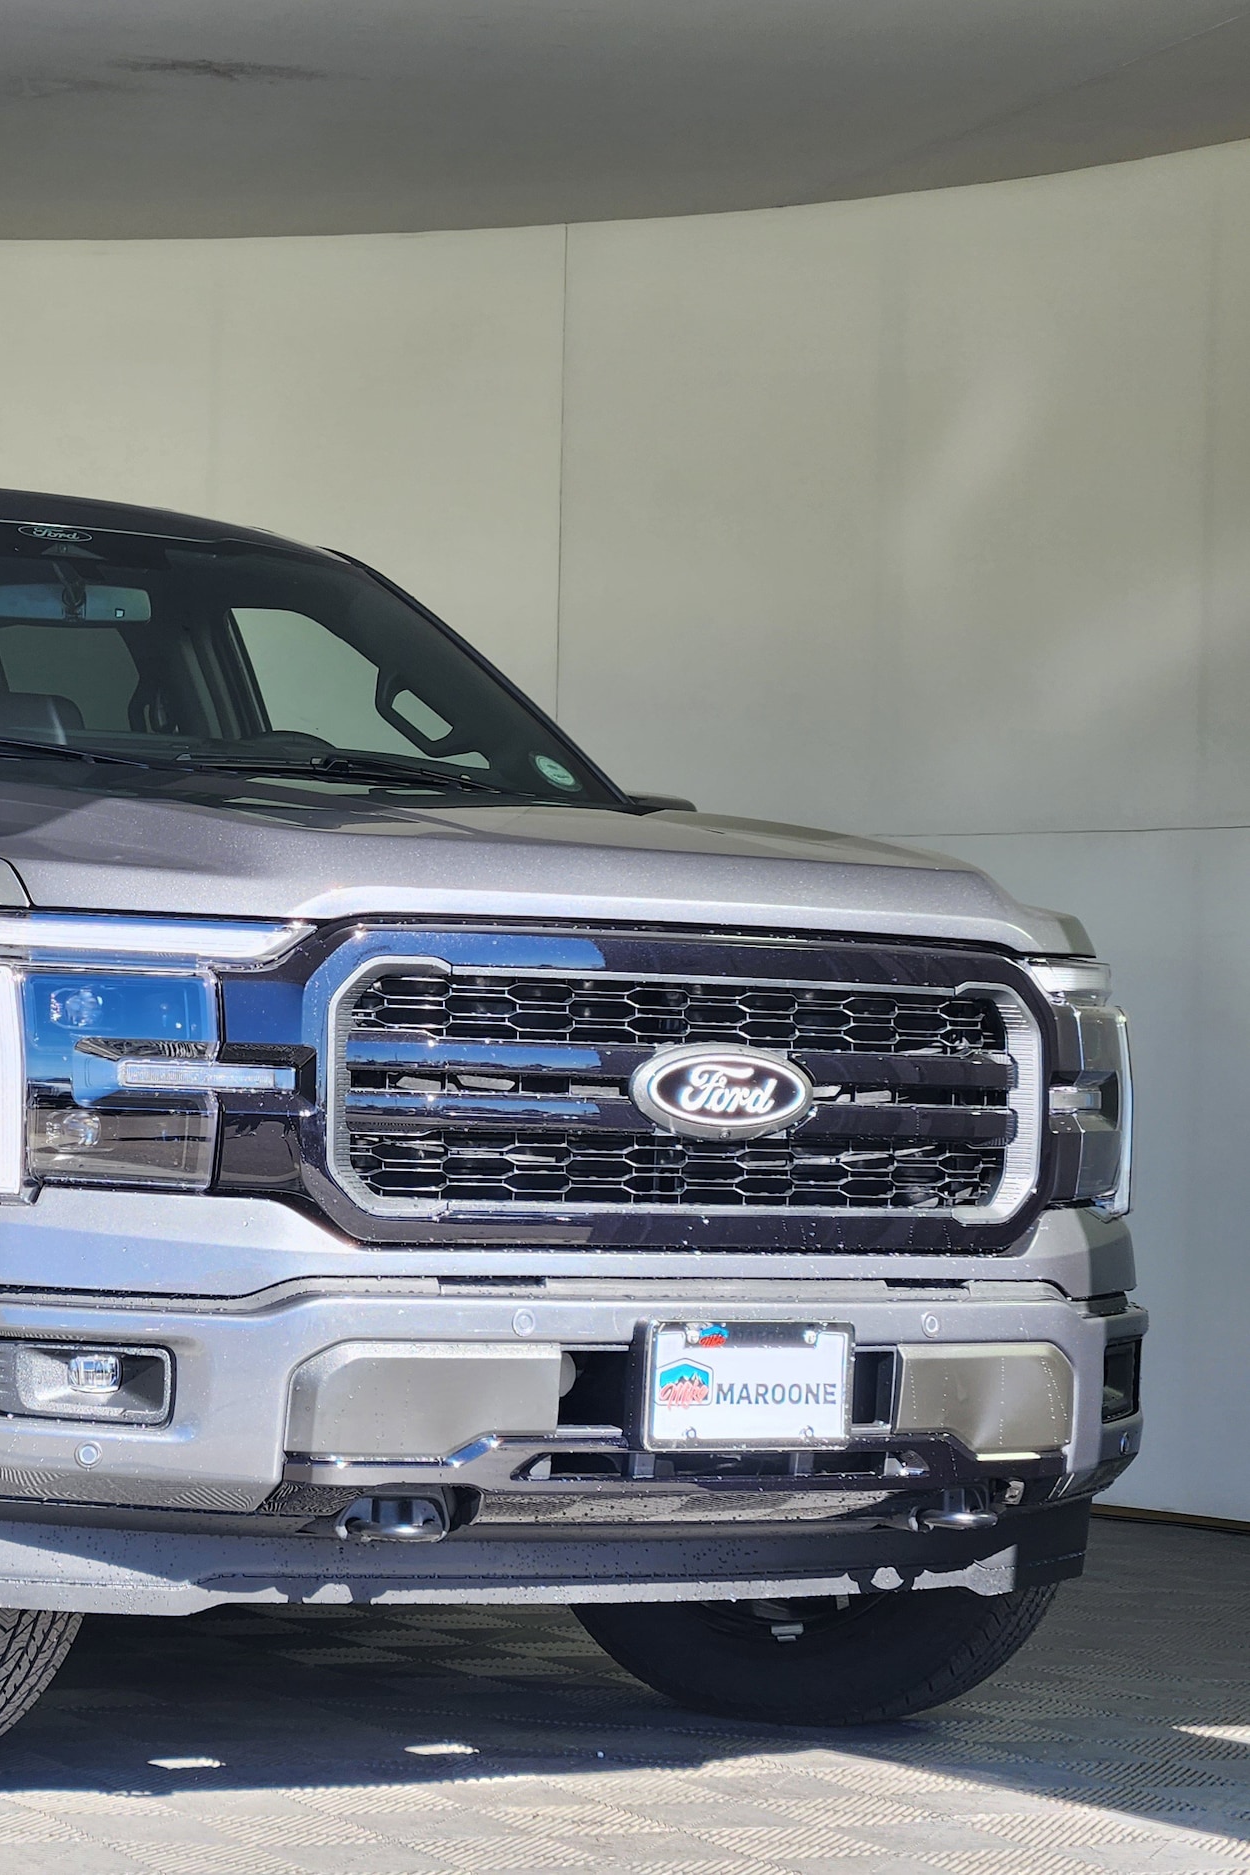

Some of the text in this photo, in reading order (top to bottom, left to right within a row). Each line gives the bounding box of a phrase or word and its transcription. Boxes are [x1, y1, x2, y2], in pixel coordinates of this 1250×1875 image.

[32, 527, 80, 540] Ford
[681, 1064, 779, 1115] Ford
[659, 1381, 710, 1410] Mike
[715, 1383, 837, 1405] MAROONE
